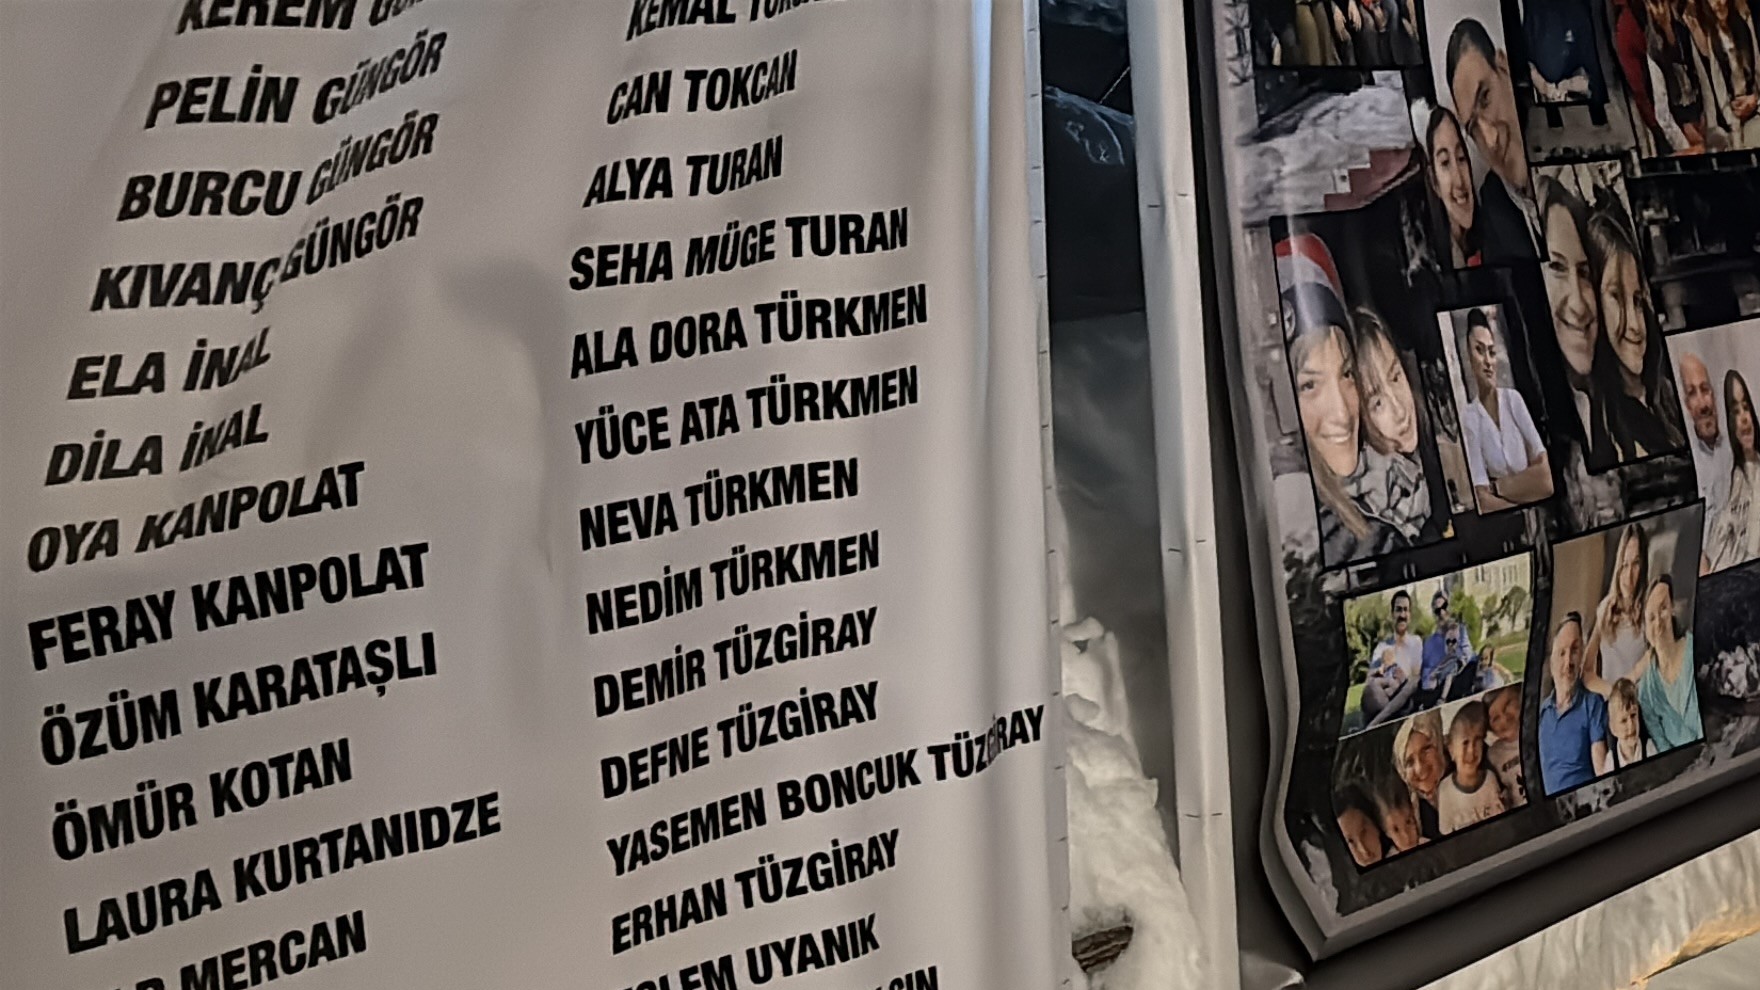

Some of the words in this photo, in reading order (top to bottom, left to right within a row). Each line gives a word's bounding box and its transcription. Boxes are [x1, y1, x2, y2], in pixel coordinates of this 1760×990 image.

[144, 64, 299, 129] PELİN
[312, 29, 447, 125] GÜNGÖR
[607, 70, 671, 125] CAN
[684, 50, 797, 112] TOKCAN
[116, 170, 302, 222] BURCU
[306, 110, 440, 206] GÜNGÖR
[583, 157, 673, 207] ALYA
[686, 136, 783, 197] TURAN
[90, 257, 282, 314] KIVANÇ
[281, 192, 424, 283] GÜNGÖR
[569, 240, 673, 291] SEHA
[685, 221, 776, 278] MÜGE
[785, 207, 908, 258] TURAN
[67, 351, 166, 400] ELA
[182, 326, 271, 392] İNAL
[570, 328, 639, 378] ALA
[650, 307, 747, 364] DORA
[754, 283, 928, 344] TÜRKMEN
[45, 429, 163, 486] DİLA
[179, 403, 269, 472] İNAL
[575, 405, 671, 465] YÜCE
[680, 395, 740, 445] ATA
[746, 365, 918, 430] TÜRKMEN
[27, 519, 119, 572] OYA
[136, 462, 365, 552] KANPOLAT
[579, 491, 678, 551] NEVA
[684, 457, 859, 527] TÜRKMEN
[28, 591, 175, 671] FERAY
[191, 543, 429, 632] KANPOLAT
[586, 565, 703, 635] NEDİM
[709, 530, 879, 602] TÜRKMEN
[40, 689, 182, 766] ÖZÜM
[193, 632, 437, 728] KARATAŞLI
[593, 645, 706, 718] DEMİR
[713, 607, 877, 680] TÜZGİRAY
[600, 727, 709, 799] DEFNE
[717, 681, 878, 759] TÜZGİRAY
[52, 779, 196, 861] ÖMÜR
[209, 738, 352, 818] KOTAN
[606, 787, 767, 877] YASEMEN
[777, 749, 921, 820] BONCUK
[63, 868, 222, 954] LAURA
[233, 792, 501, 902] KURTANIDZE
[612, 879, 726, 955] ERHAN
[735, 829, 899, 909] TÜZGİRAY
[747, 913, 879, 986] UYANIK
